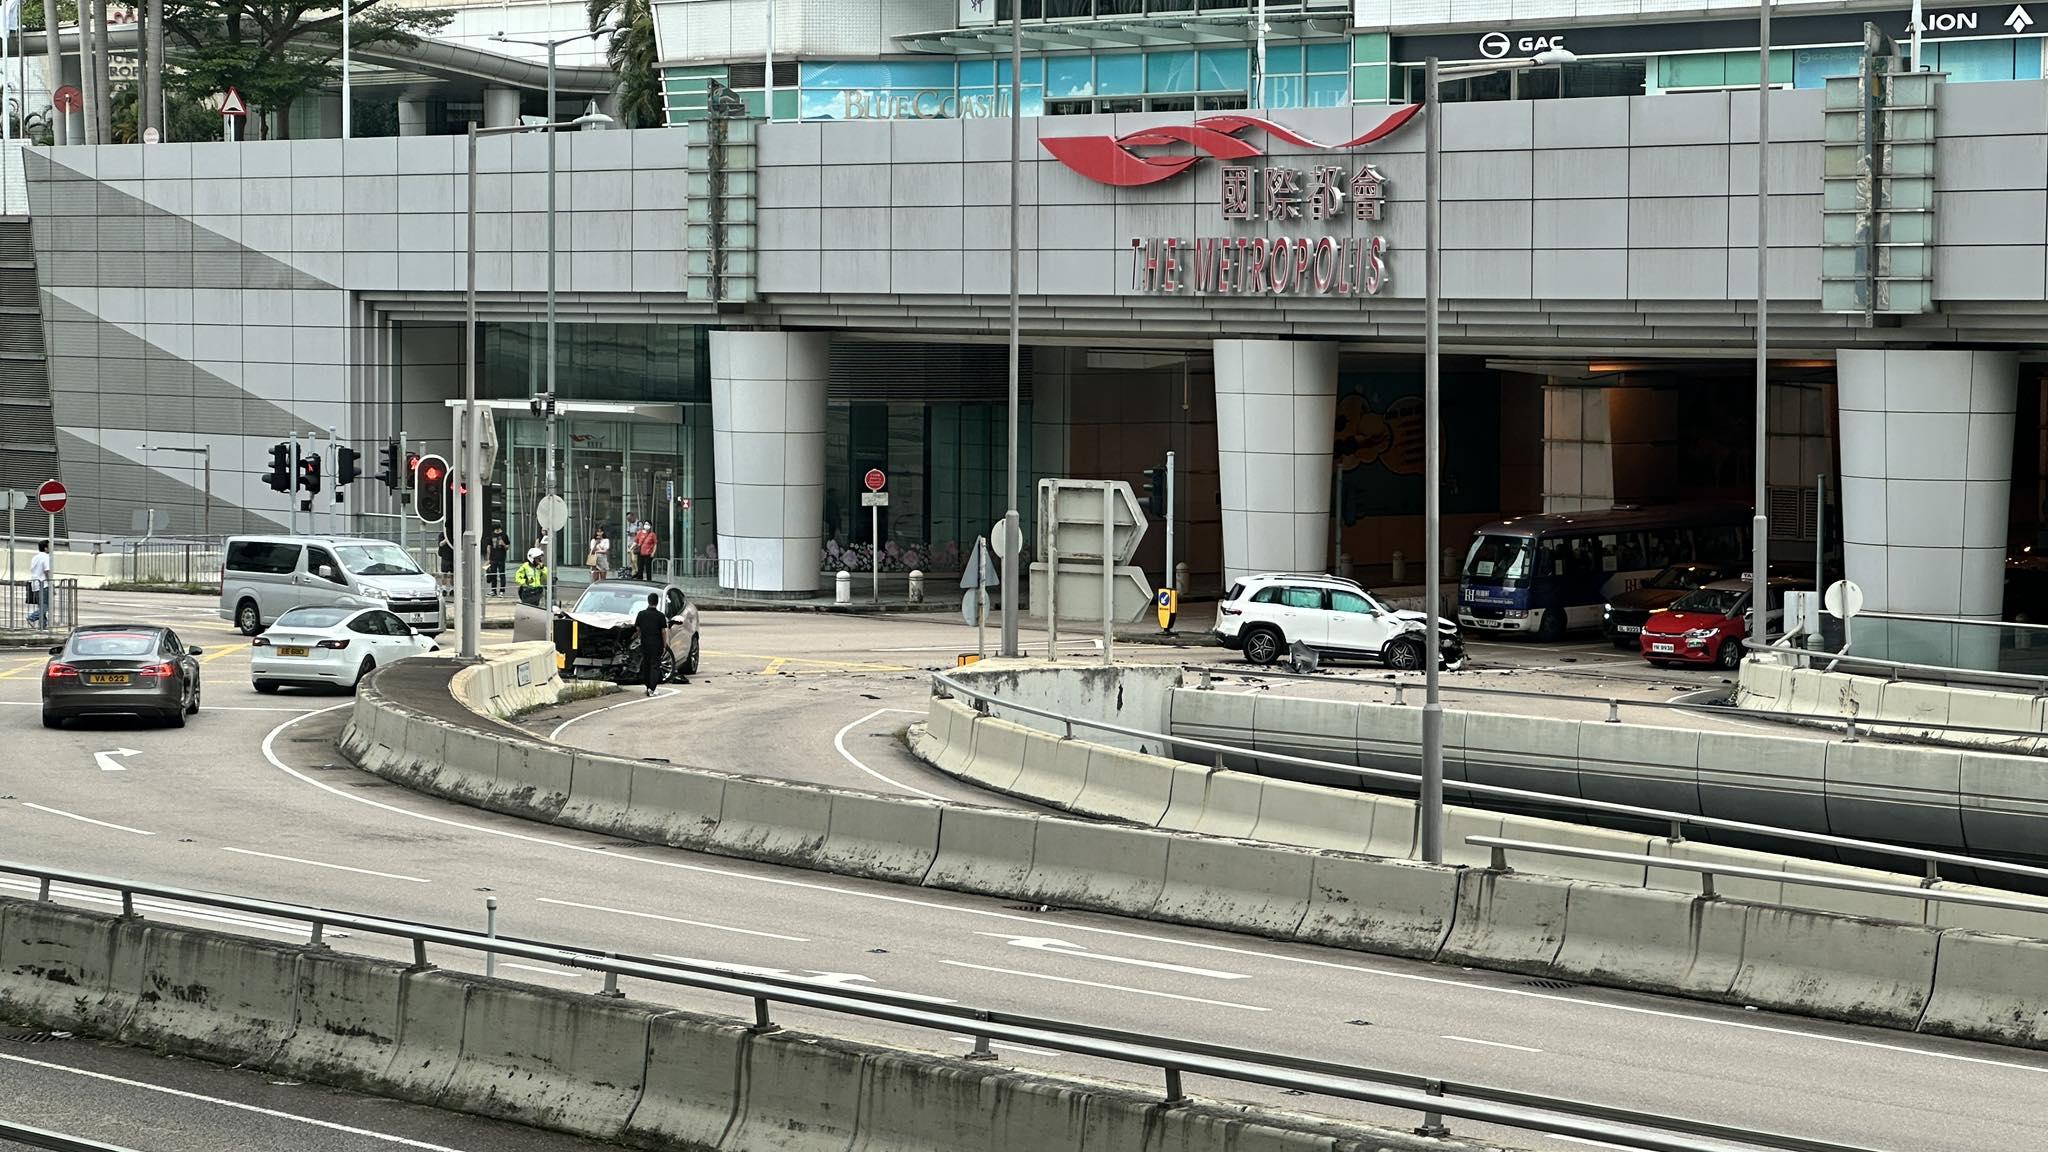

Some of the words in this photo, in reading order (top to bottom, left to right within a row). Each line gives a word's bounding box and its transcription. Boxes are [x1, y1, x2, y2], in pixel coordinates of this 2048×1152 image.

[1518, 36, 1564, 51] GAC
[1220, 164, 1388, 220] 國際都會
[1131, 237, 1182, 292] THE
[1194, 235, 1387, 294] METROPOLIS
